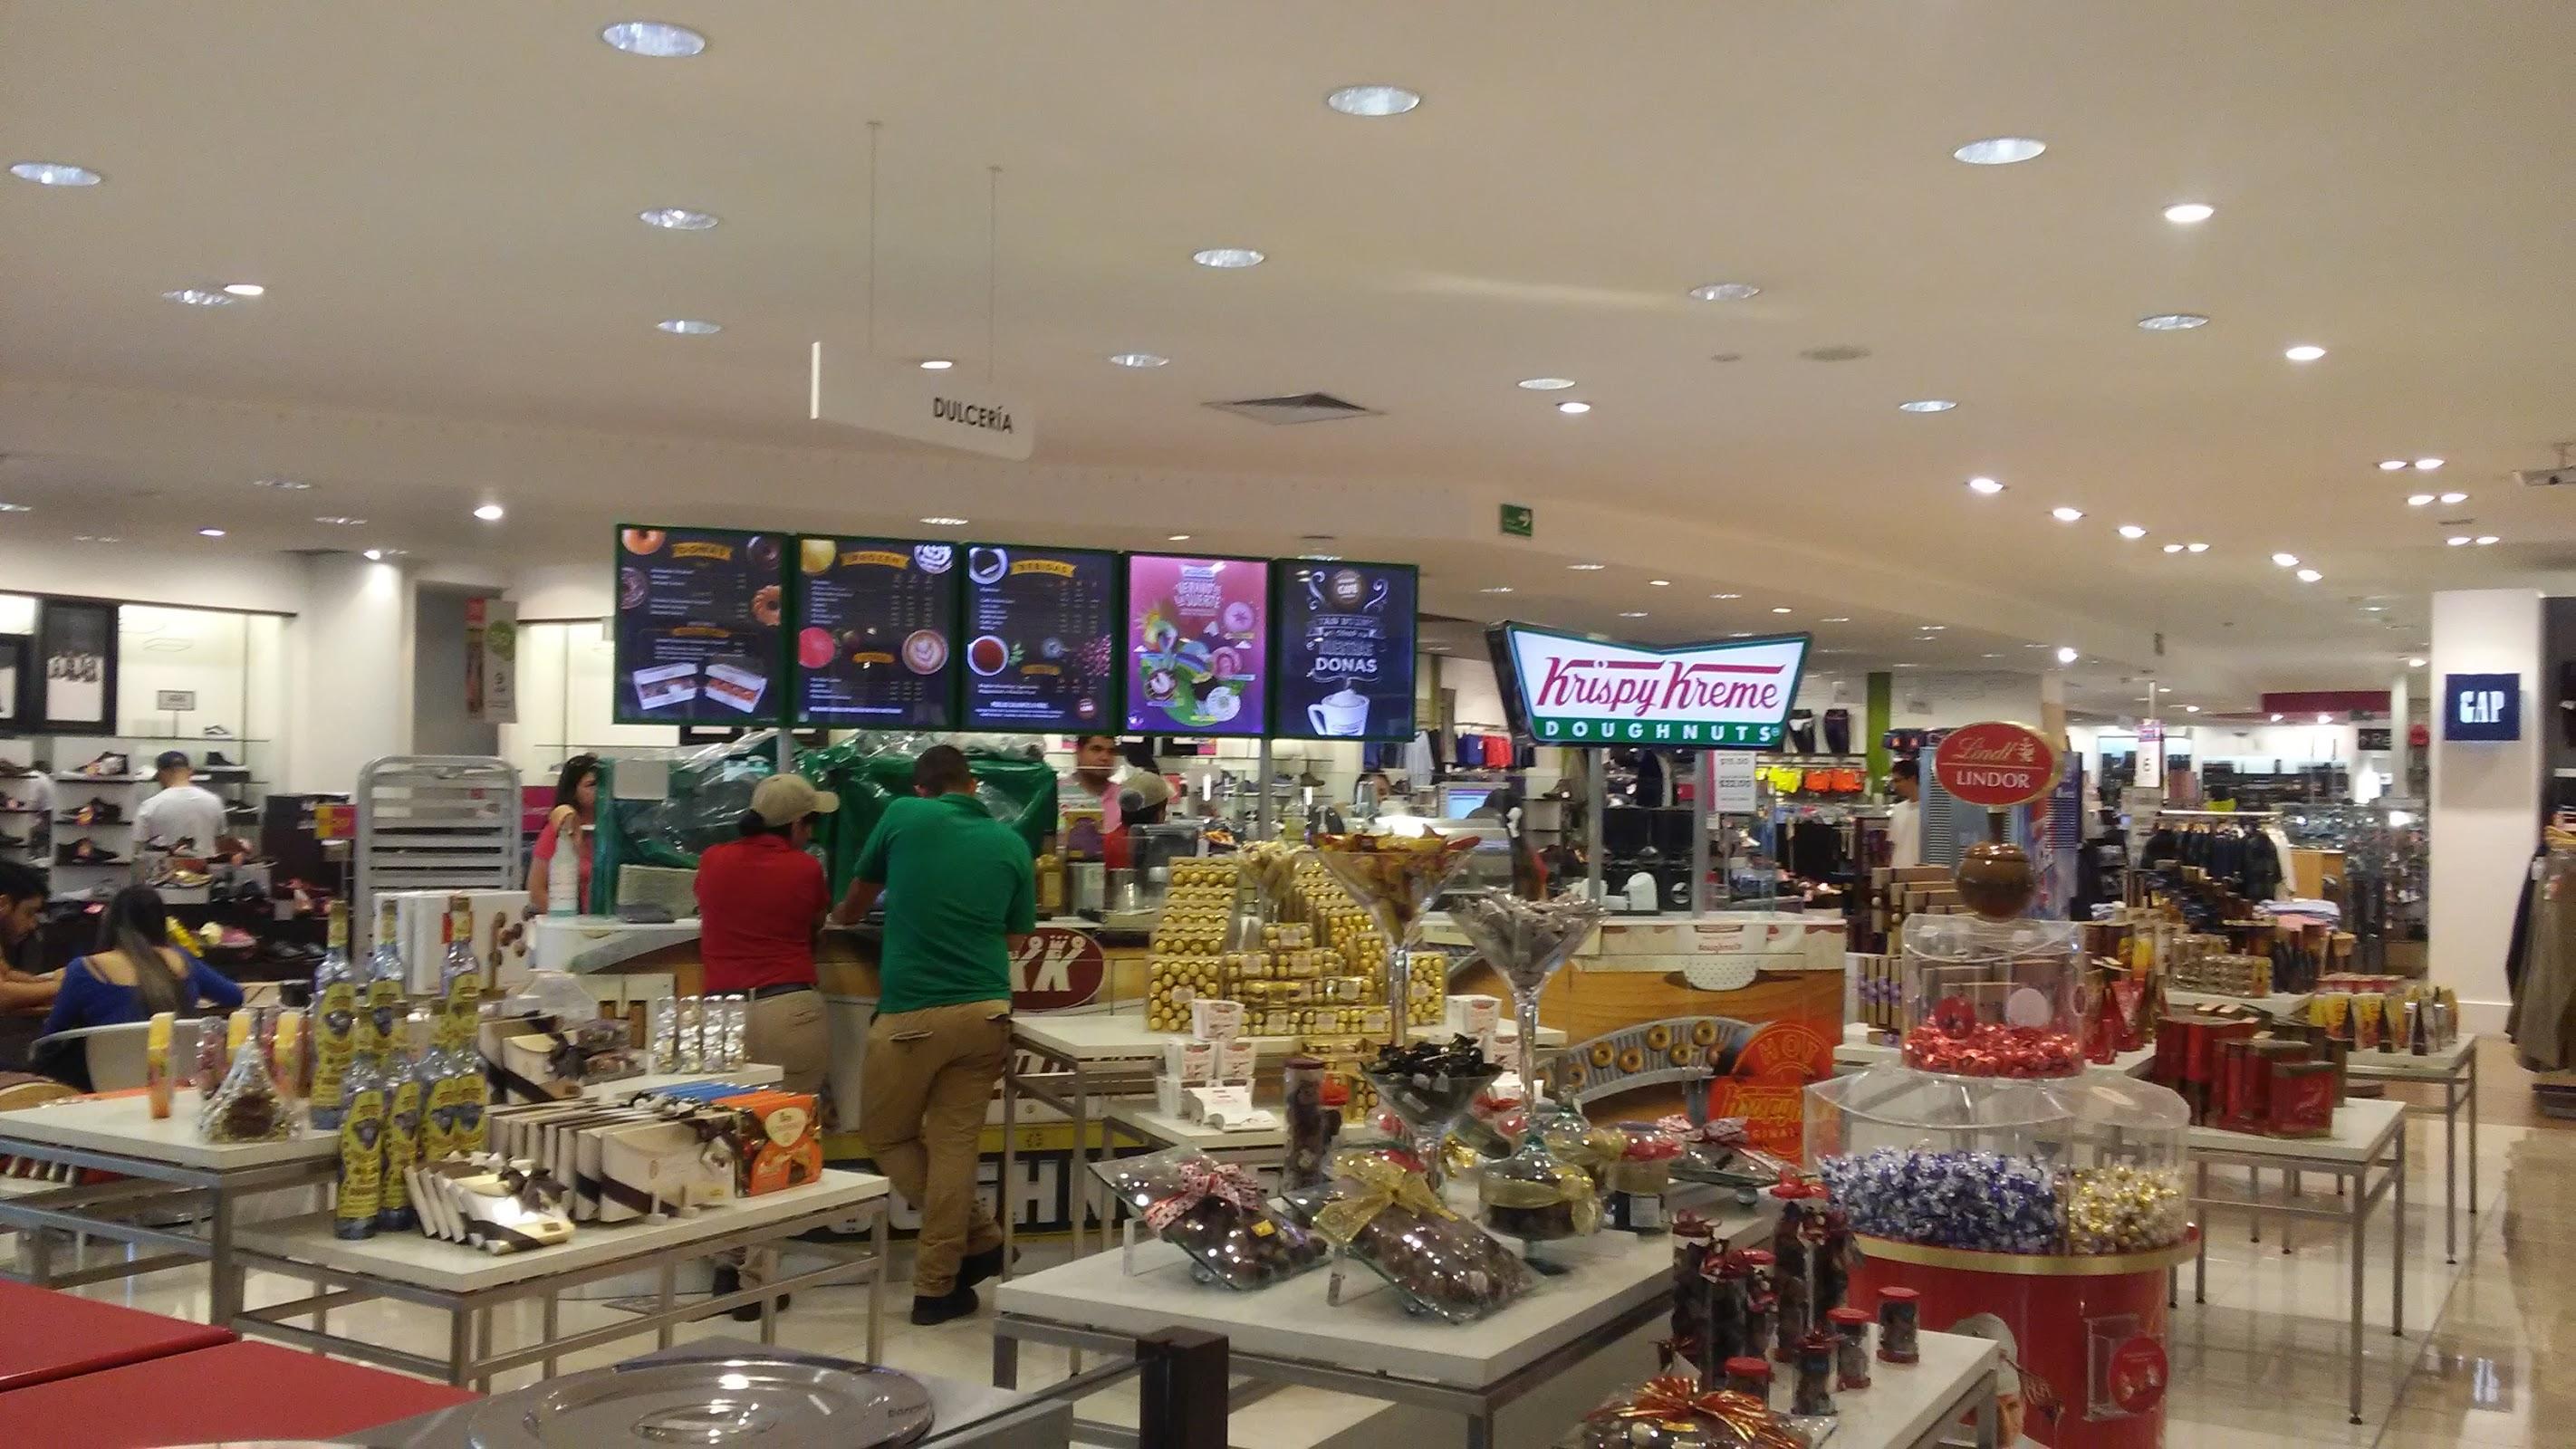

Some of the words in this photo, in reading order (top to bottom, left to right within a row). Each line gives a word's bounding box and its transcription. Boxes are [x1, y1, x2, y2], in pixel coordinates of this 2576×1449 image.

[933, 396, 1014, 434] DULCERÍA
[1314, 657, 1378, 673] DONAS
[1535, 657, 1666, 717] Krispy
[1659, 661, 1786, 710] Kreme
[2459, 690, 2505, 724] GAP
[1544, 720, 1772, 742] DOUGHNUTS
[1952, 736, 2019, 762] Lindt
[1956, 770, 2031, 789] LINDOR
